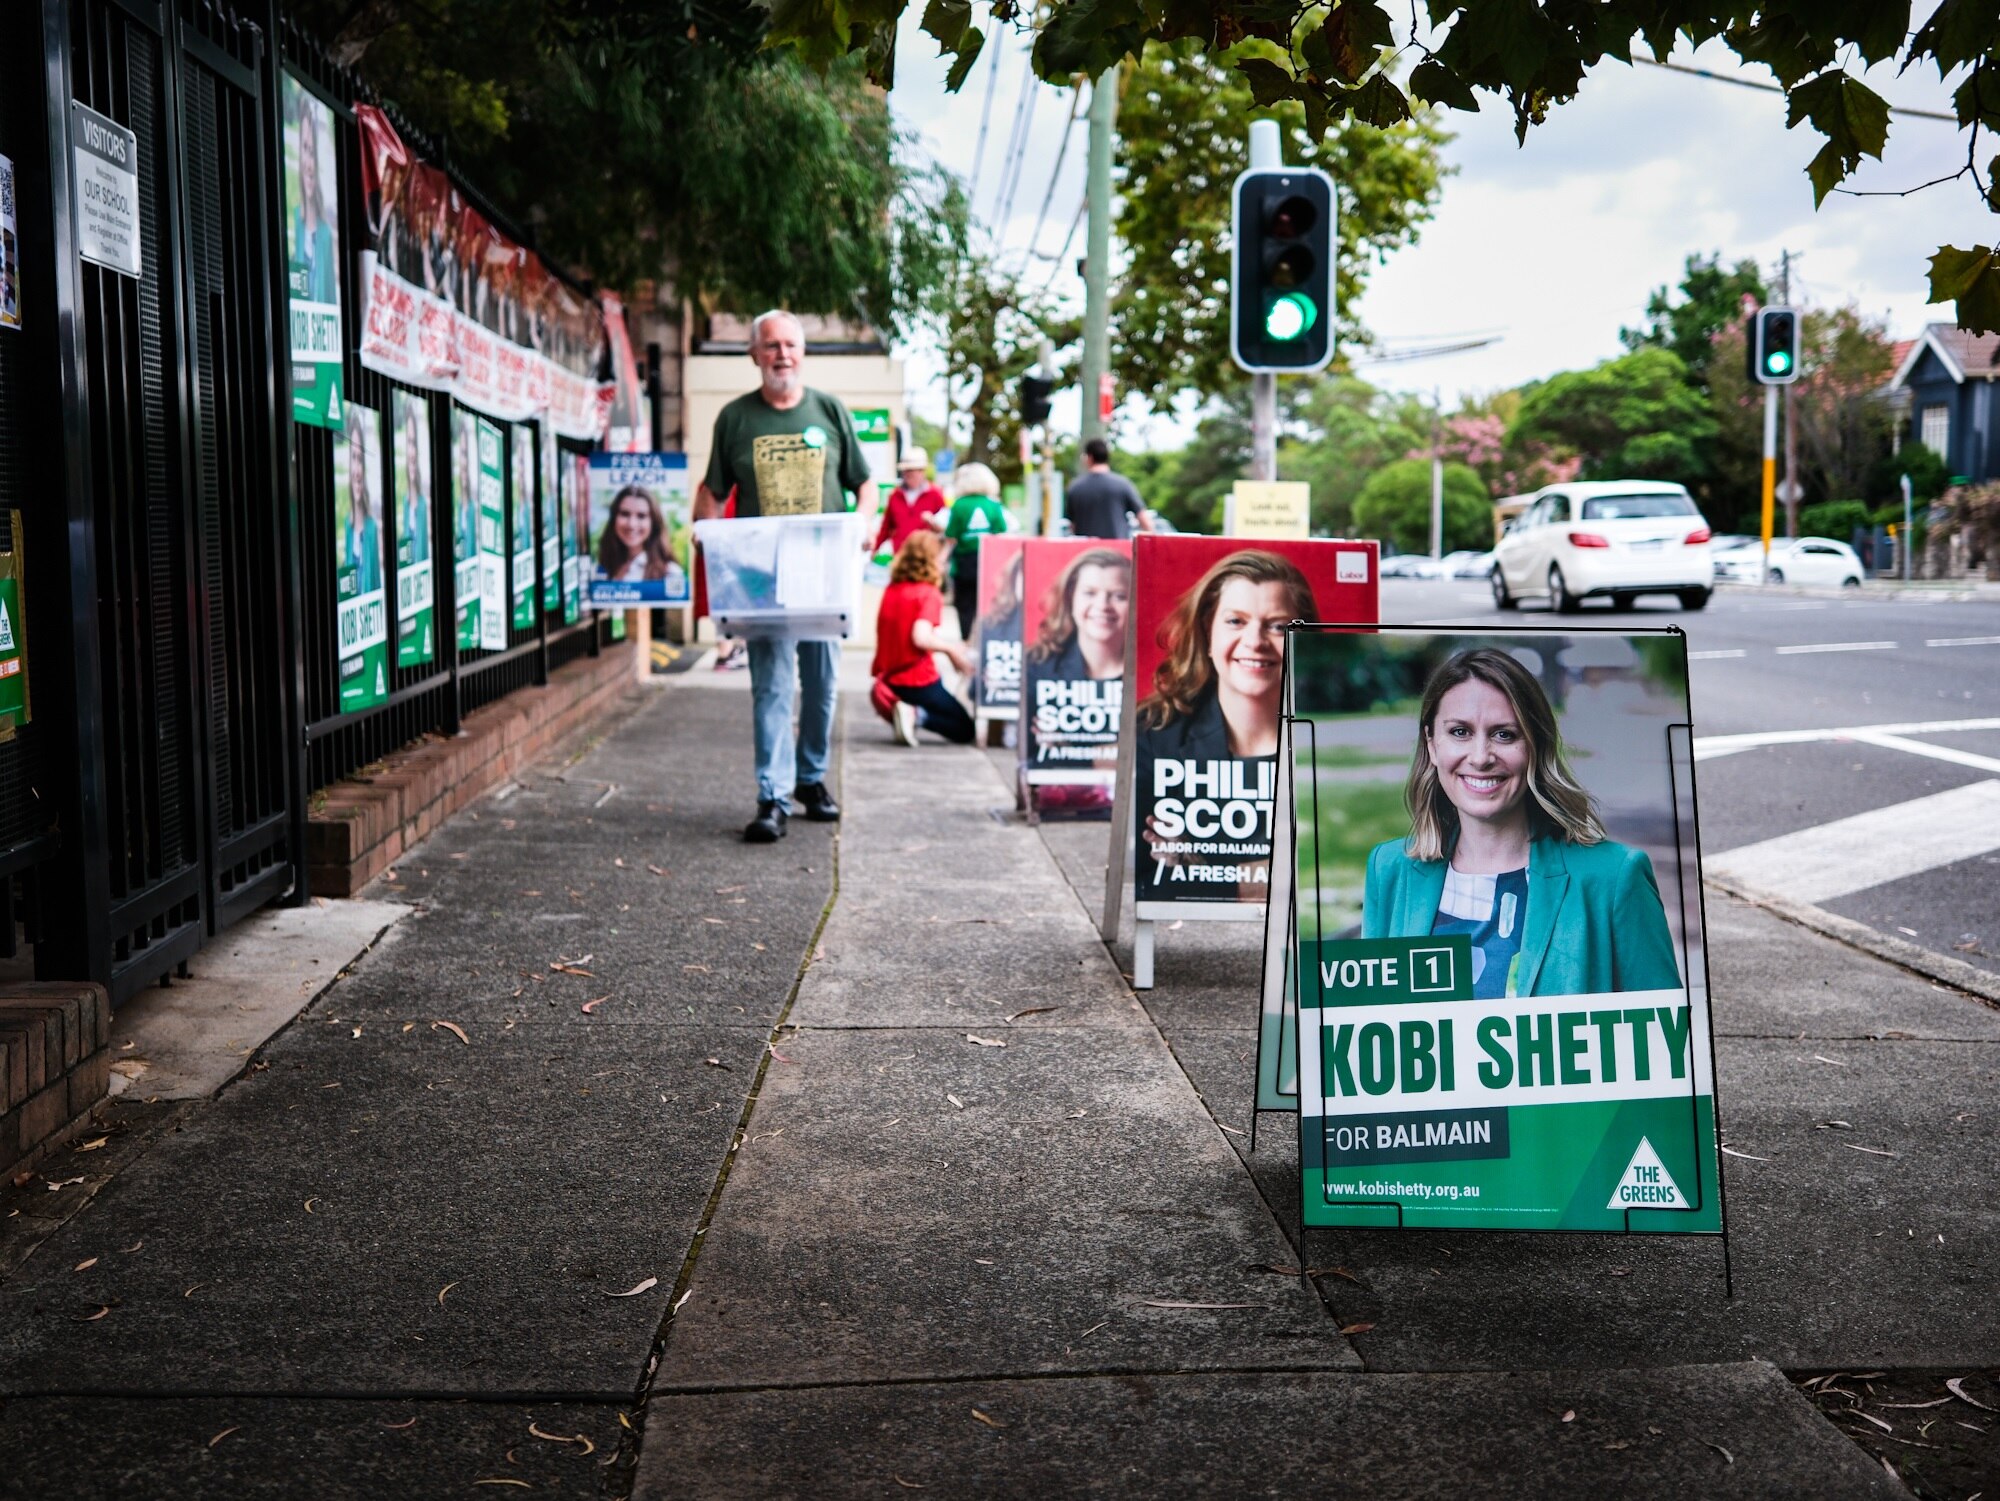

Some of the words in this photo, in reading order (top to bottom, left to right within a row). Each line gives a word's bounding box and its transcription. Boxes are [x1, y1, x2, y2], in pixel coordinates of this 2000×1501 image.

[83, 118, 126, 163] VISITORS
[85, 179, 101, 202] OUR
[102, 187, 131, 215] SCHOOL
[291, 309, 309, 350] KOBI
[312, 313, 339, 352] SHETTY
[611, 453, 664, 468] FREYA
[609, 470, 666, 485] LEACH
[1339, 570, 1365, 580] Labor
[341, 607, 358, 648] KOBI
[359, 599, 384, 640] SHETTY
[1153, 758, 1276, 800] PHILI
[1152, 842, 1192, 855] LABOR
[1193, 842, 1219, 855] FOR
[1170, 864, 1187, 882] A
[1188, 865, 1251, 883] FRESH
[1320, 957, 1399, 988] VOTE
[1425, 956, 1439, 984] 1
[1320, 1018, 1455, 1098] KOBI
[1477, 1005, 1692, 1090] SHETTY
[1376, 1120, 1491, 1149] BALMAIN
[1633, 1165, 1661, 1183] THE
[1322, 1180, 1480, 1200] www.kobishetty.org.au
[1619, 1185, 1675, 1203] GREENS
